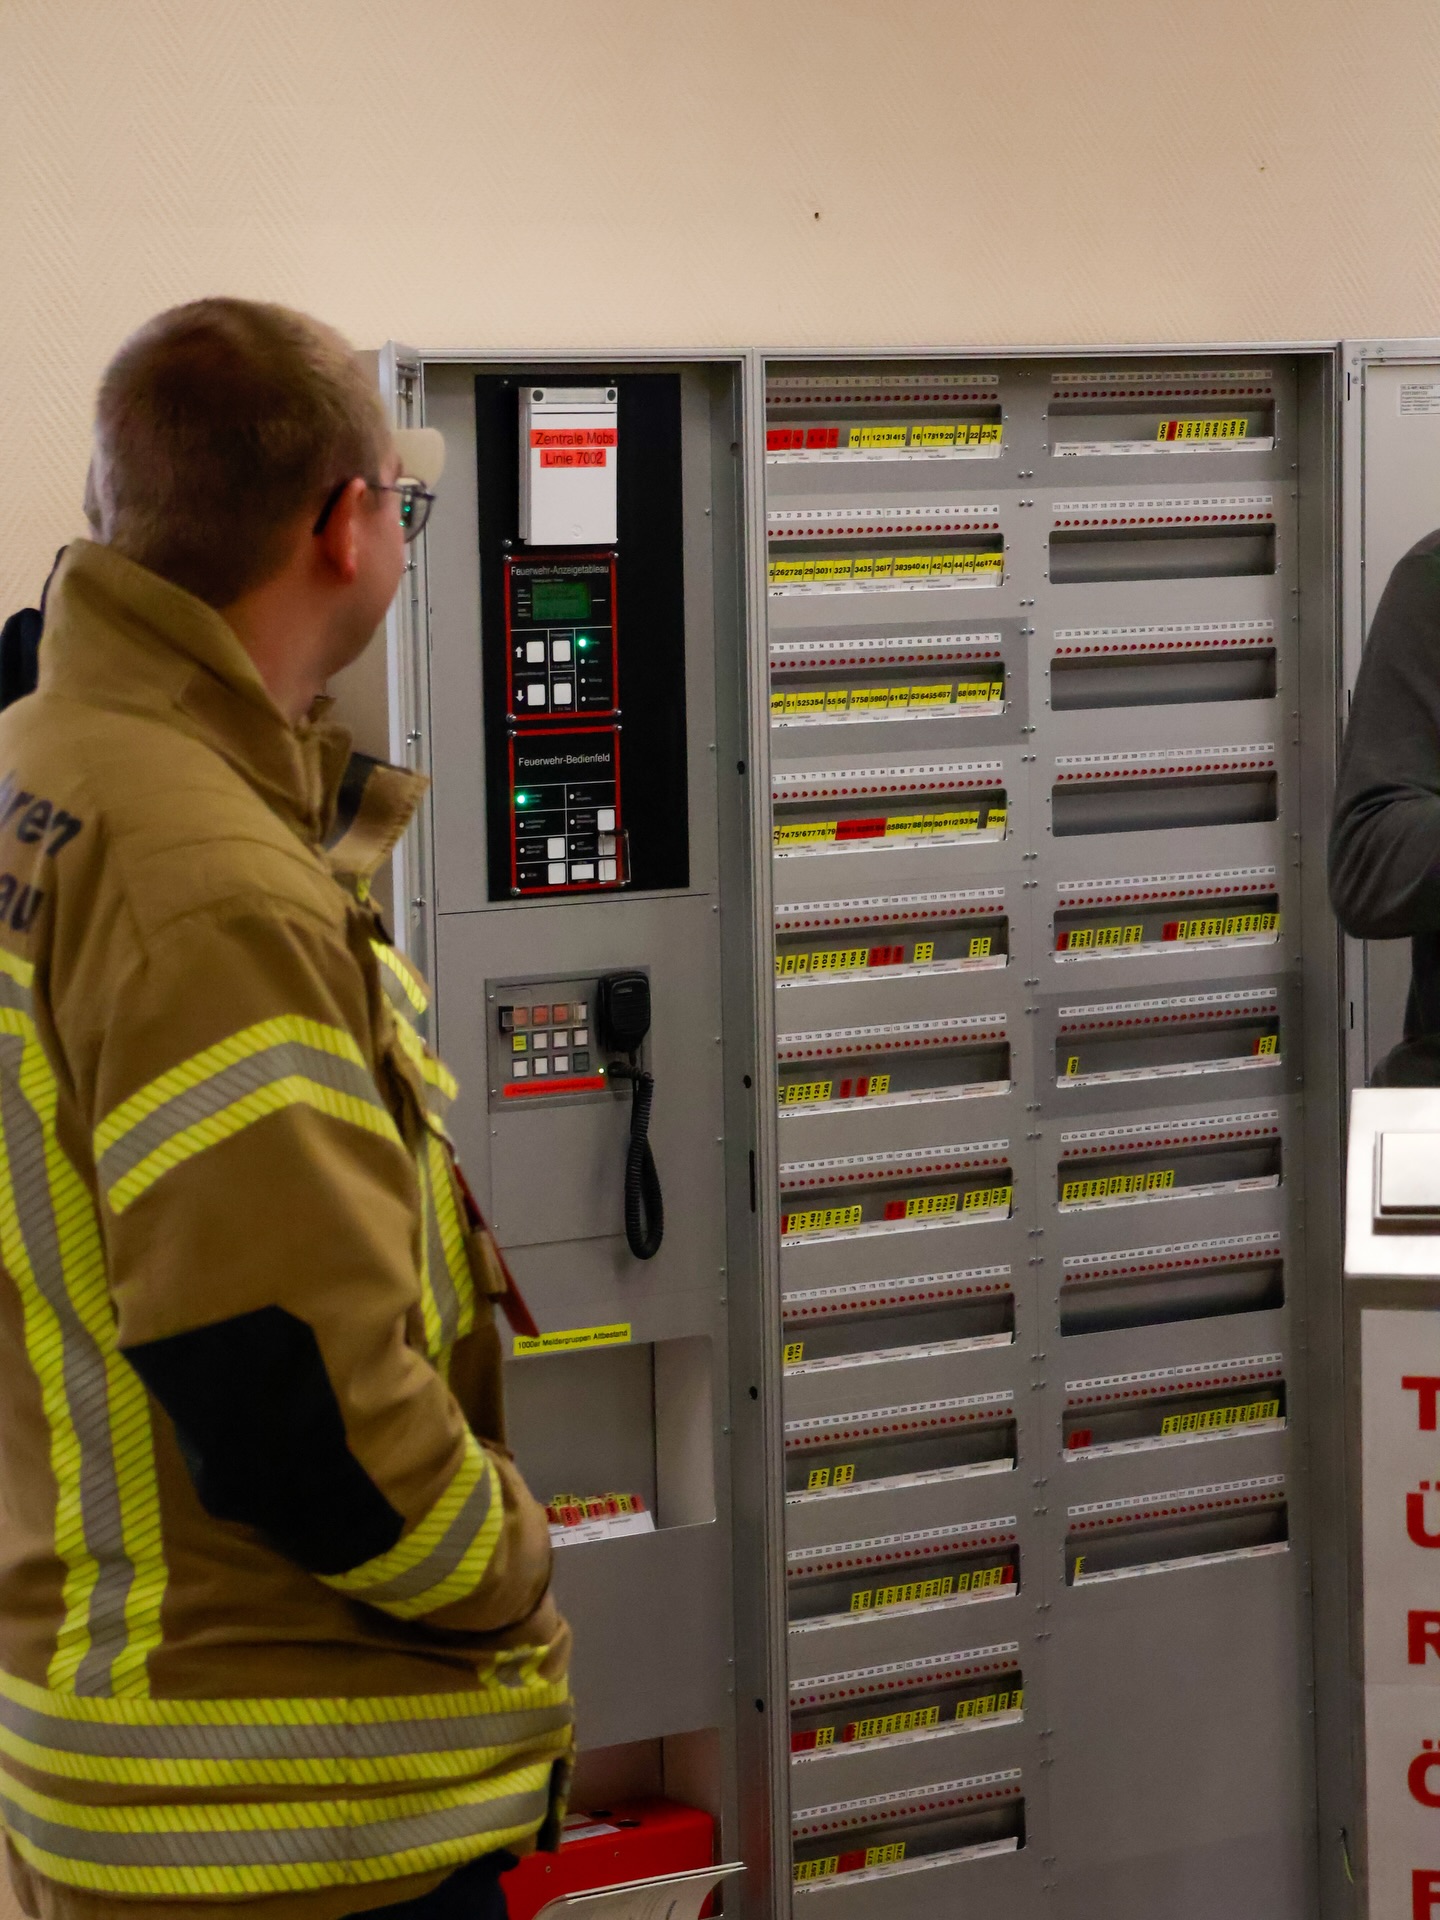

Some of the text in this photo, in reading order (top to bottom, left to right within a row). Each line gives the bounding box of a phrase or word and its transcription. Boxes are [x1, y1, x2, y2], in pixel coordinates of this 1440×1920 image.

[1204, 422, 1212, 437] 305
[1238, 421, 1246, 436] 309
[535, 432, 615, 446] Zentrale Mobs
[546, 451, 604, 465] Linie 7002
[511, 565, 609, 577] Feuerwehr-Anzeigetableau
[518, 753, 611, 767] Feuerwehr-Bedienfeld
[787, 960, 794, 970] 98
[518, 1341, 541, 1349] 1000er
[542, 1335, 591, 1346] Meldergruppen
